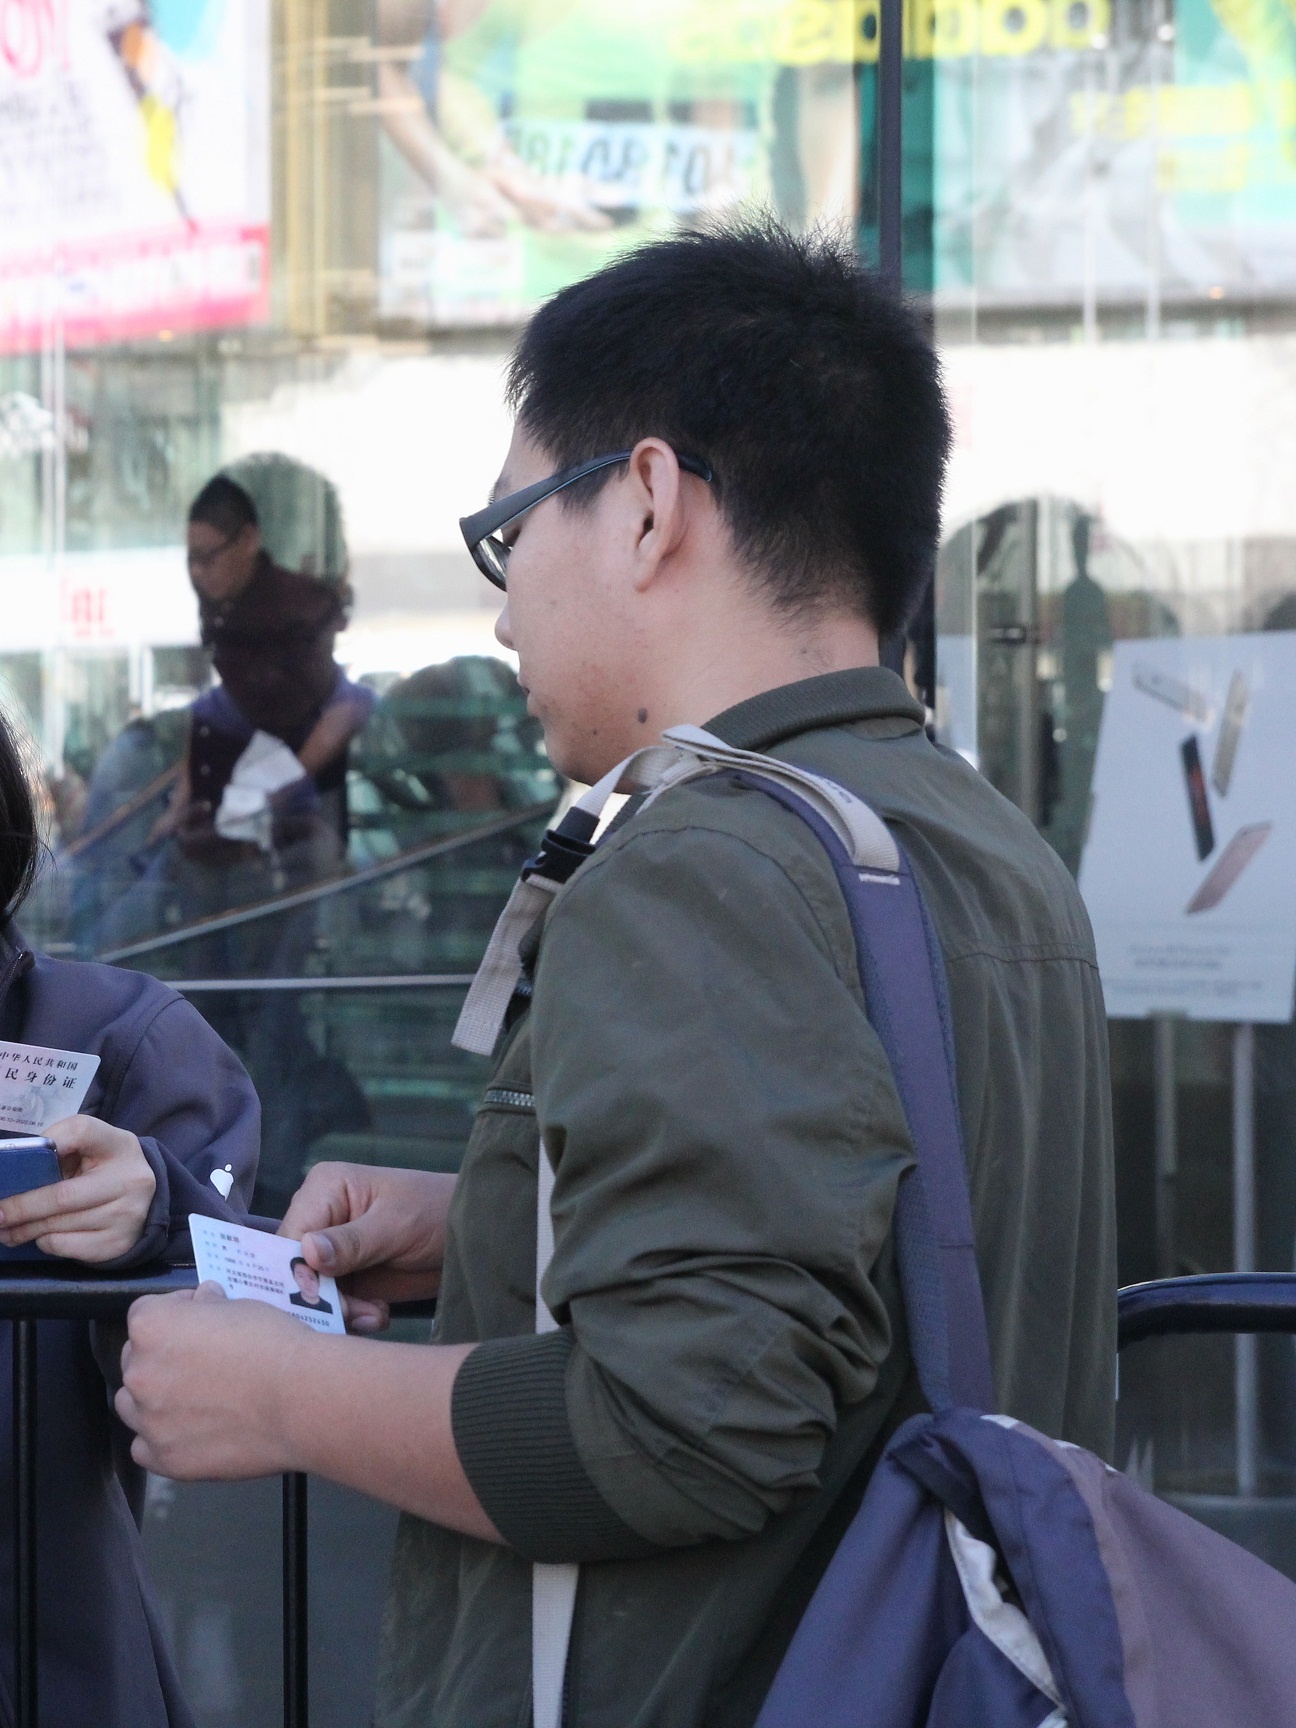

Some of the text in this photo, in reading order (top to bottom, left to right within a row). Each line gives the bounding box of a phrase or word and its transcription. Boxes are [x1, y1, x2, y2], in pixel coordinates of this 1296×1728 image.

[0, 1051, 79, 1071] 中华人民共和国
